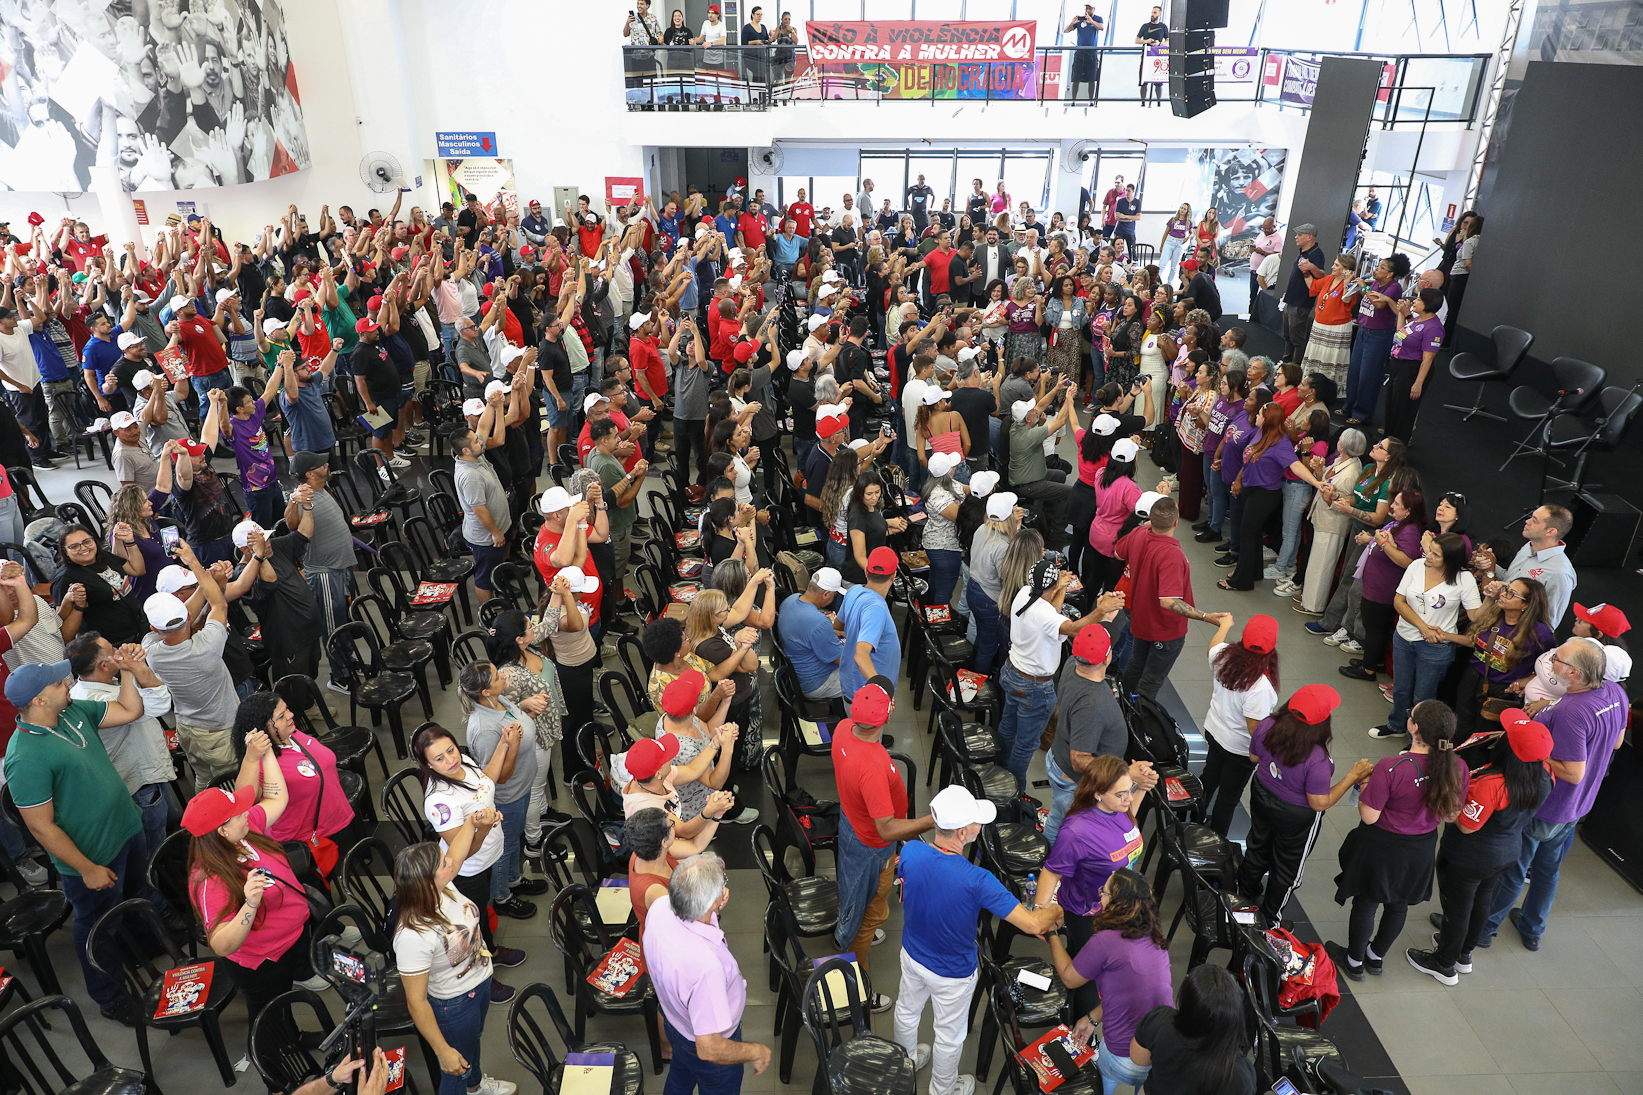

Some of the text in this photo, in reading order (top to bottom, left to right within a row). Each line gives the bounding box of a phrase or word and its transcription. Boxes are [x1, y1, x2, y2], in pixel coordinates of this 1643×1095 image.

[811, 23, 1001, 44] NÃO À VIOLÊNCIA
[812, 44, 1001, 60] CONTRA A MULHER
[904, 65, 1024, 91] DEMOCRACIA
[438, 140, 480, 148] Masculinos
[439, 133, 478, 141] Sanitários
[1463, 800, 1485, 822] 31
